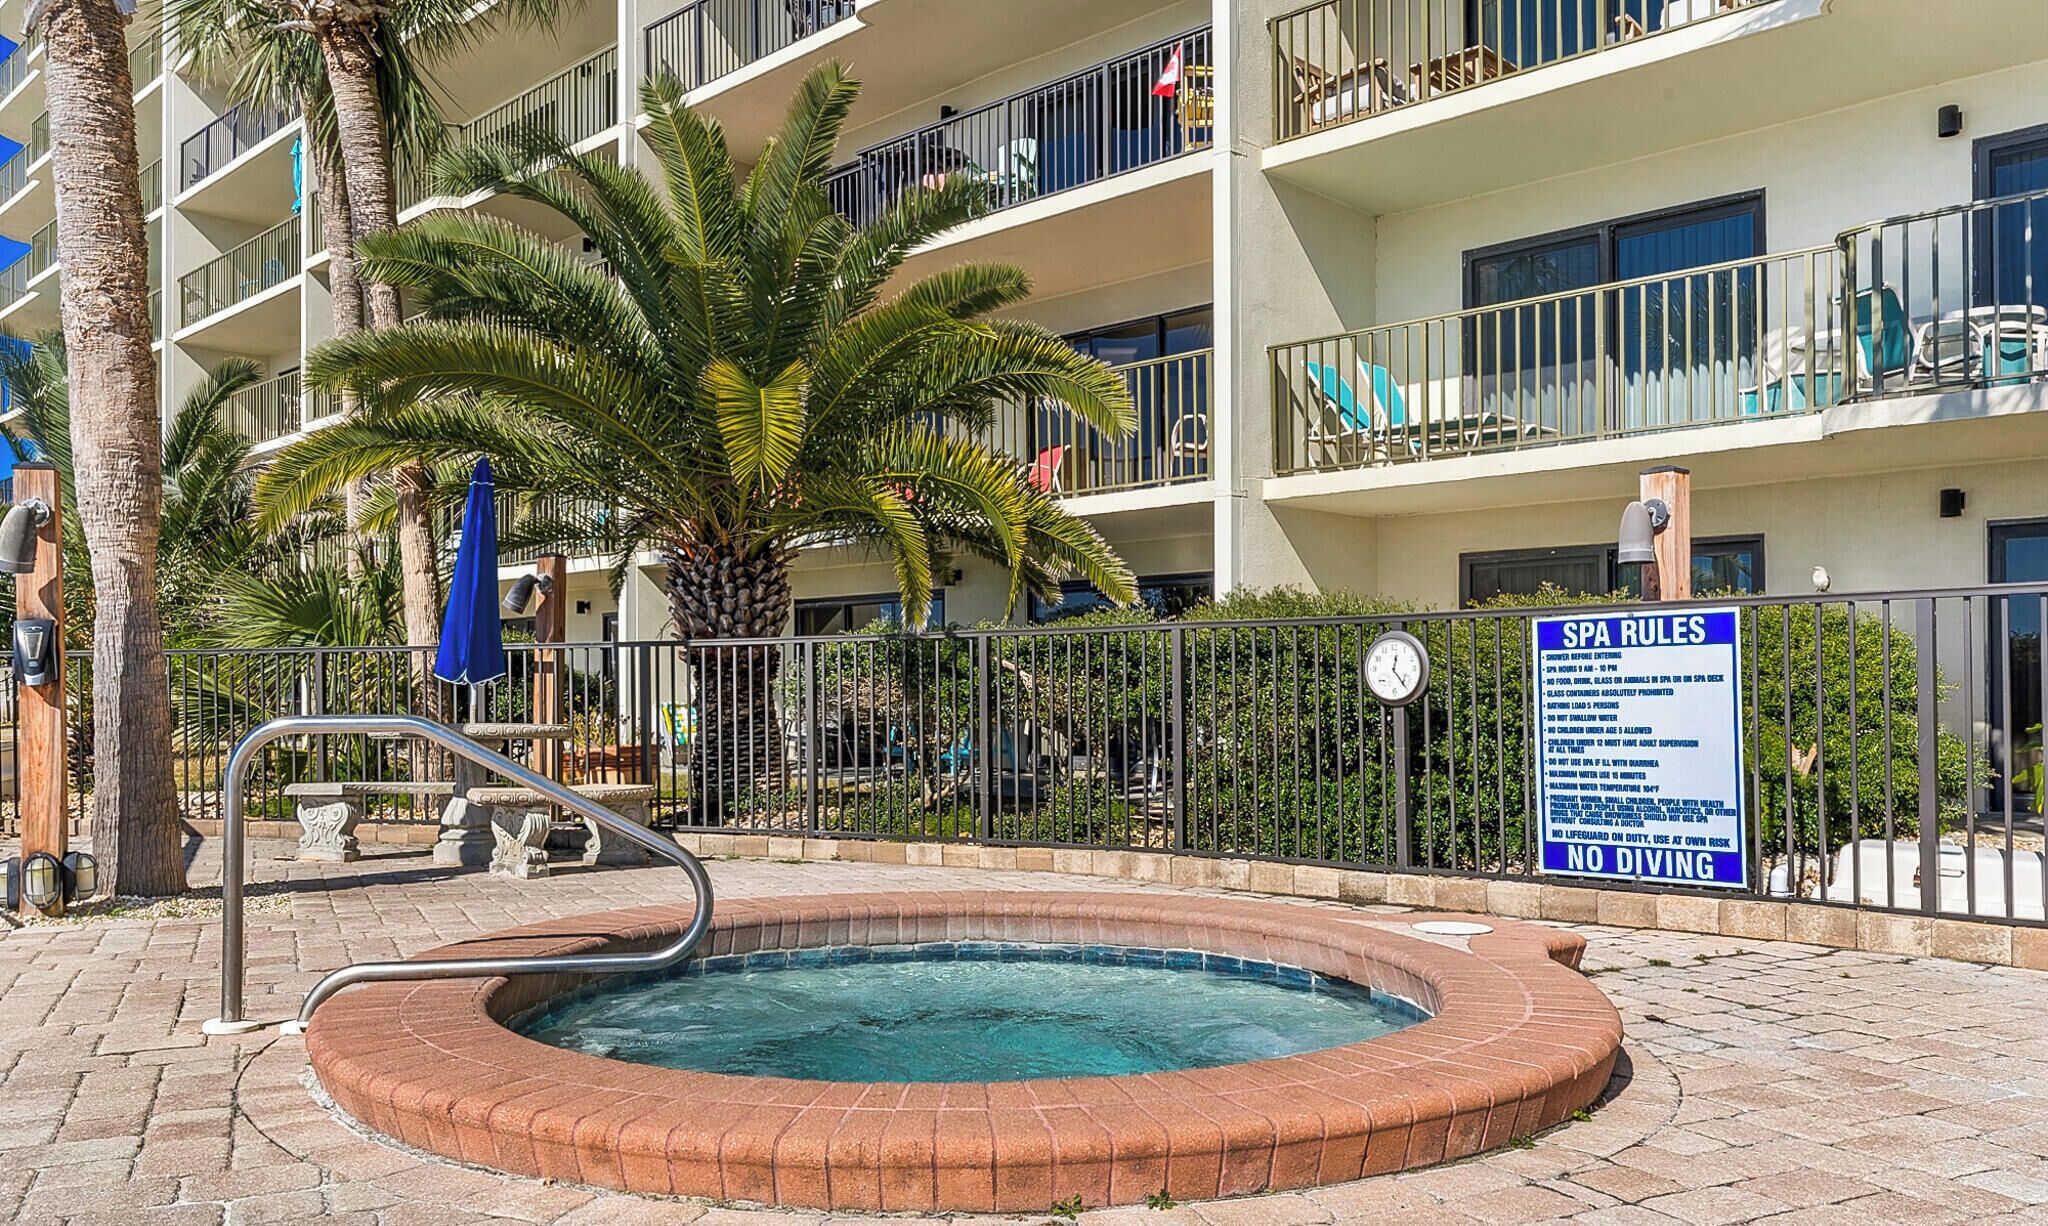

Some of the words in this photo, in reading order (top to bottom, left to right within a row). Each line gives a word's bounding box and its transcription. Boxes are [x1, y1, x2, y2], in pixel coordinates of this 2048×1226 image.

[1563, 621, 1610, 648] SPA
[1621, 616, 1706, 646] RULES
[1623, 739, 1637, 747] HAVE
[1639, 739, 1657, 747] ADULT
[1659, 739, 1698, 747] SUPERVISION
[1600, 771, 1610, 779] USE
[1620, 772, 1646, 780] MINUTES
[1550, 782, 1578, 790] MAXIMUM
[1600, 784, 1640, 792] TEMPERATURE
[1580, 795, 1603, 803] WOMEN,
[1626, 796, 1656, 806] CHILDREN,
[1658, 798, 1680, 806] PEOPLE
[1701, 800, 1724, 808] HEALTH
[1636, 804, 1665, 814] ALCOHOL,
[1667, 807, 1703, 816] NARCOTICS,
[1605, 812, 1642, 820] DROWSINESS
[1579, 818, 1613, 826] CONSULTING
[1552, 829, 1563, 838] NO
[1566, 830, 1609, 841] LIFEGUARD
[1612, 832, 1623, 842] ON
[1626, 834, 1650, 844] DUTY,
[1653, 835, 1669, 844] USE
[1672, 836, 1682, 845] AT
[1685, 836, 1706, 846] OWN
[1709, 838, 1730, 848] RISK
[1568, 845, 1603, 872] NO
[1617, 847, 1714, 880] DIVING
